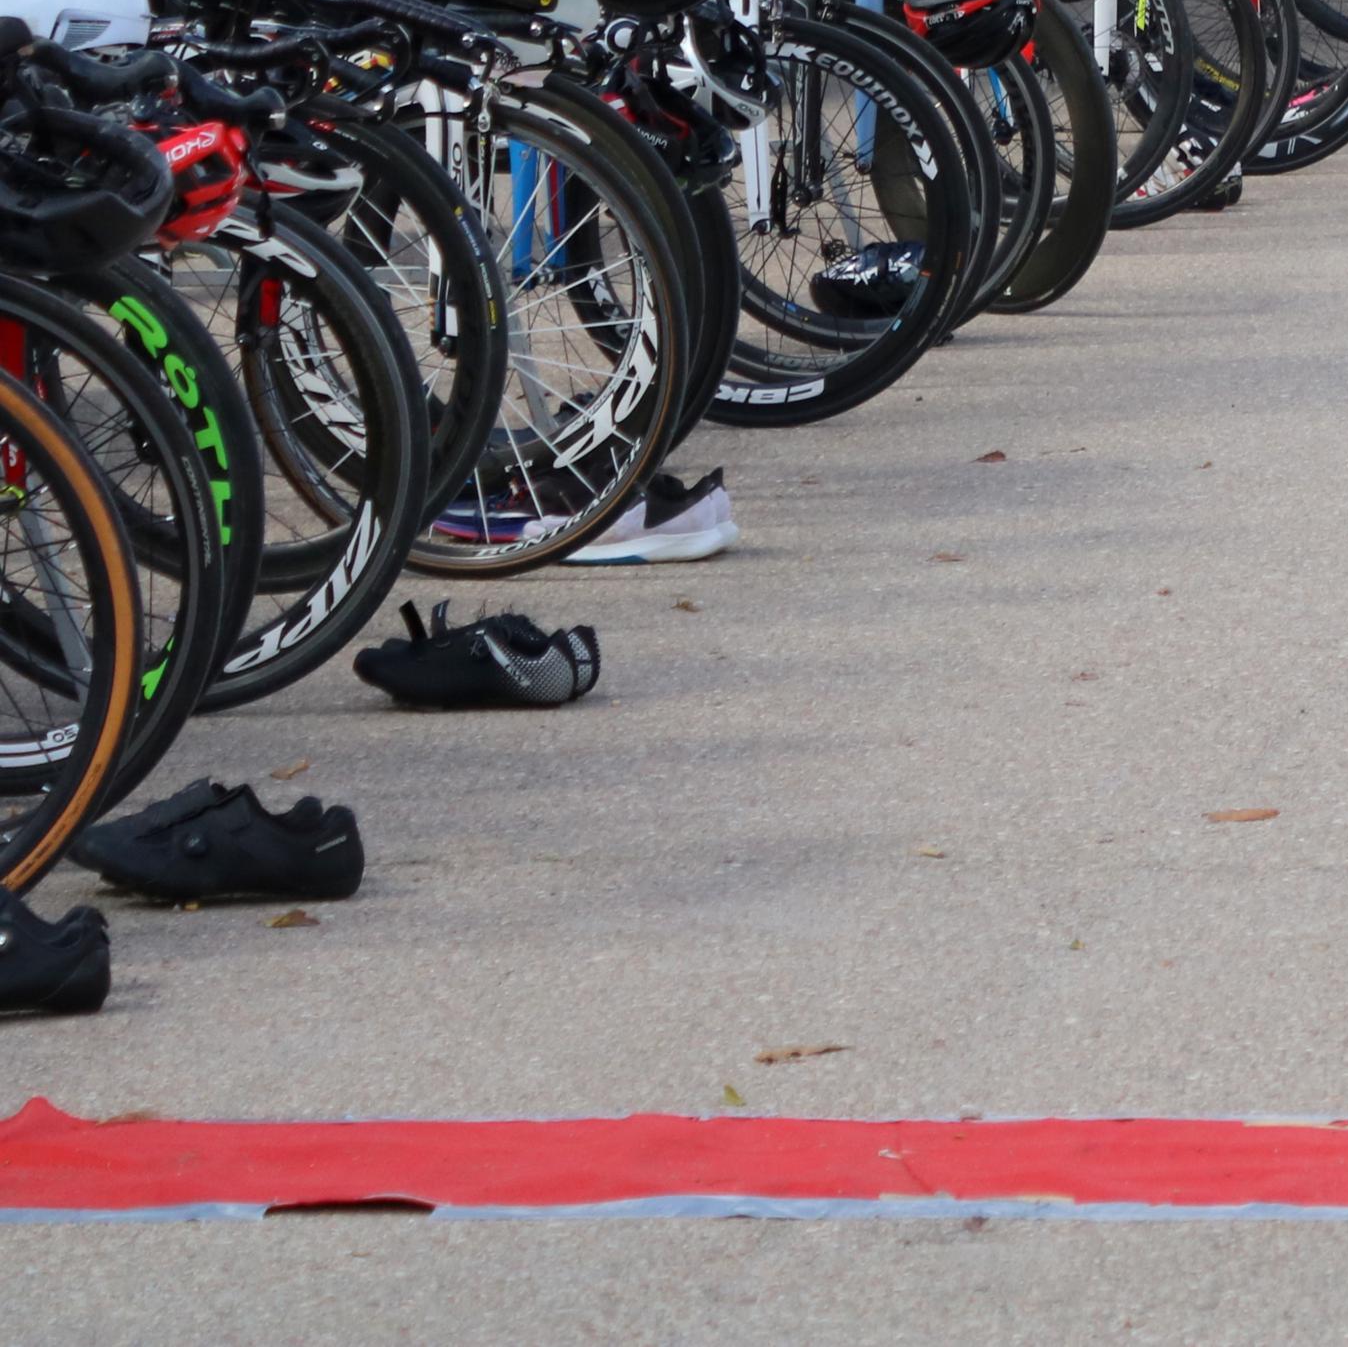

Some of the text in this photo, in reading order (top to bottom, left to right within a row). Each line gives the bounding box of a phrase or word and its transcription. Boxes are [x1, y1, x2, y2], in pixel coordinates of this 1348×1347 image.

[815, 52, 924, 141] EQUINOX
[474, 439, 642, 557] BONTRAGER
[223, 499, 382, 674] ZIPP
